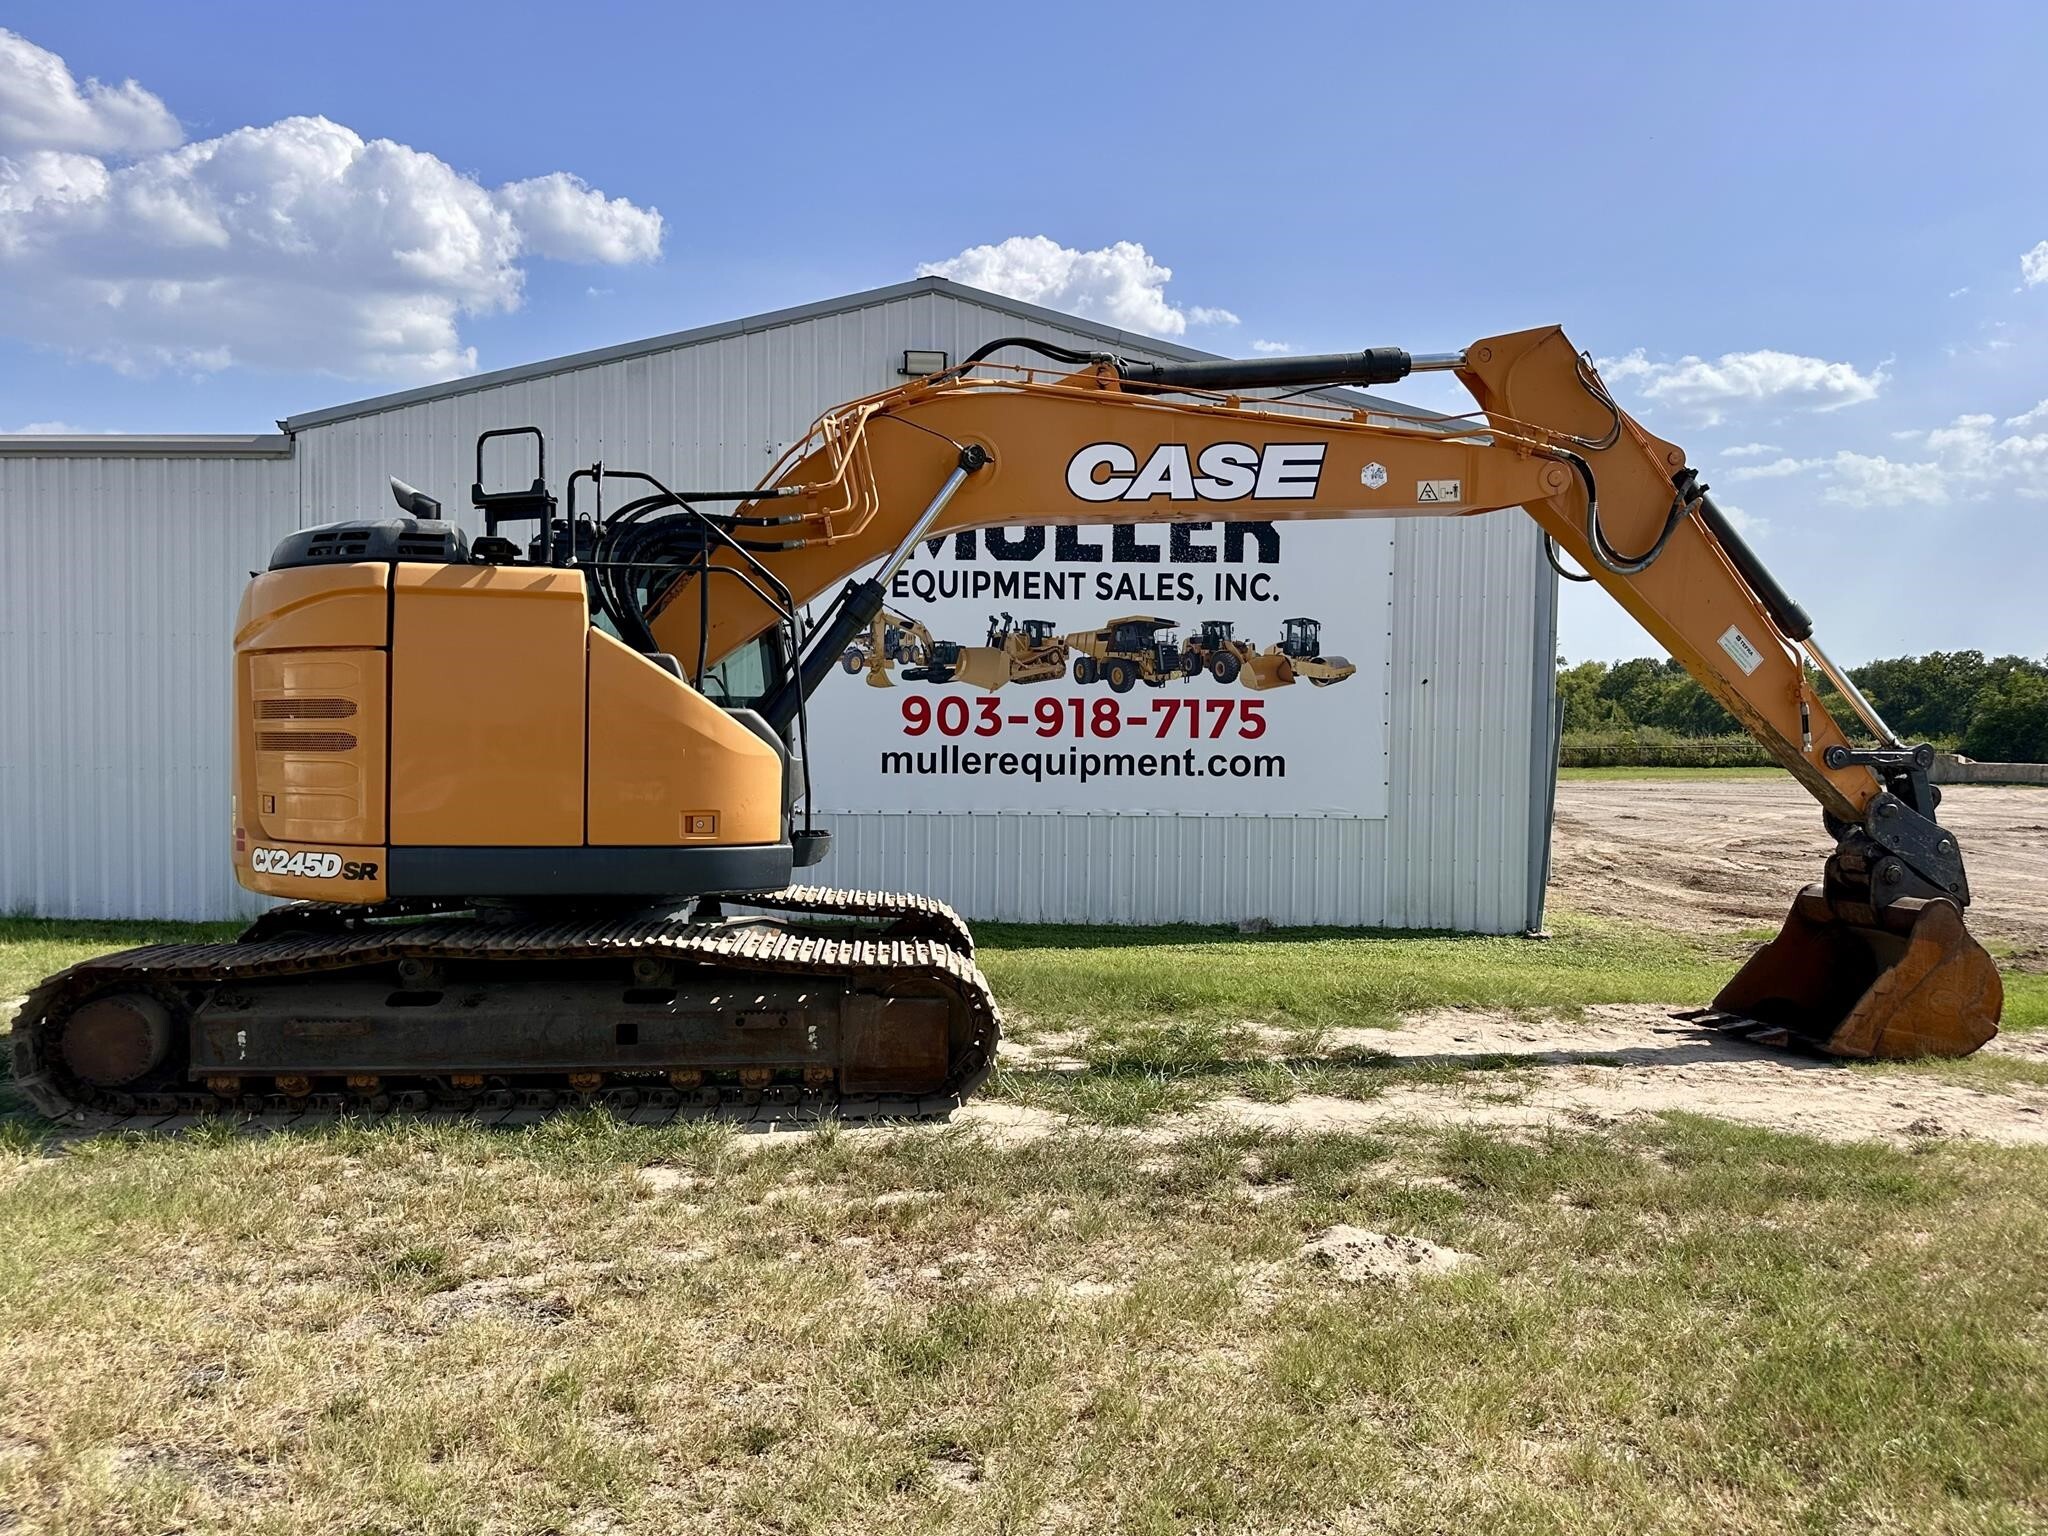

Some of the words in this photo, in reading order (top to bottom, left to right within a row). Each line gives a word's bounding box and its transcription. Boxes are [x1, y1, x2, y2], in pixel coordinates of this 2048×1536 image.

[1065, 441, 1328, 502] CASE
[892, 569, 1086, 603] EQUIPMENT
[1095, 571, 1204, 605] SALES,
[1215, 572, 1280, 602] INC.
[901, 695, 1267, 740] 903-918-7175
[881, 744, 1286, 784] mullerequipment.com
[252, 847, 342, 878] CX245D
[343, 862, 378, 880] SR
